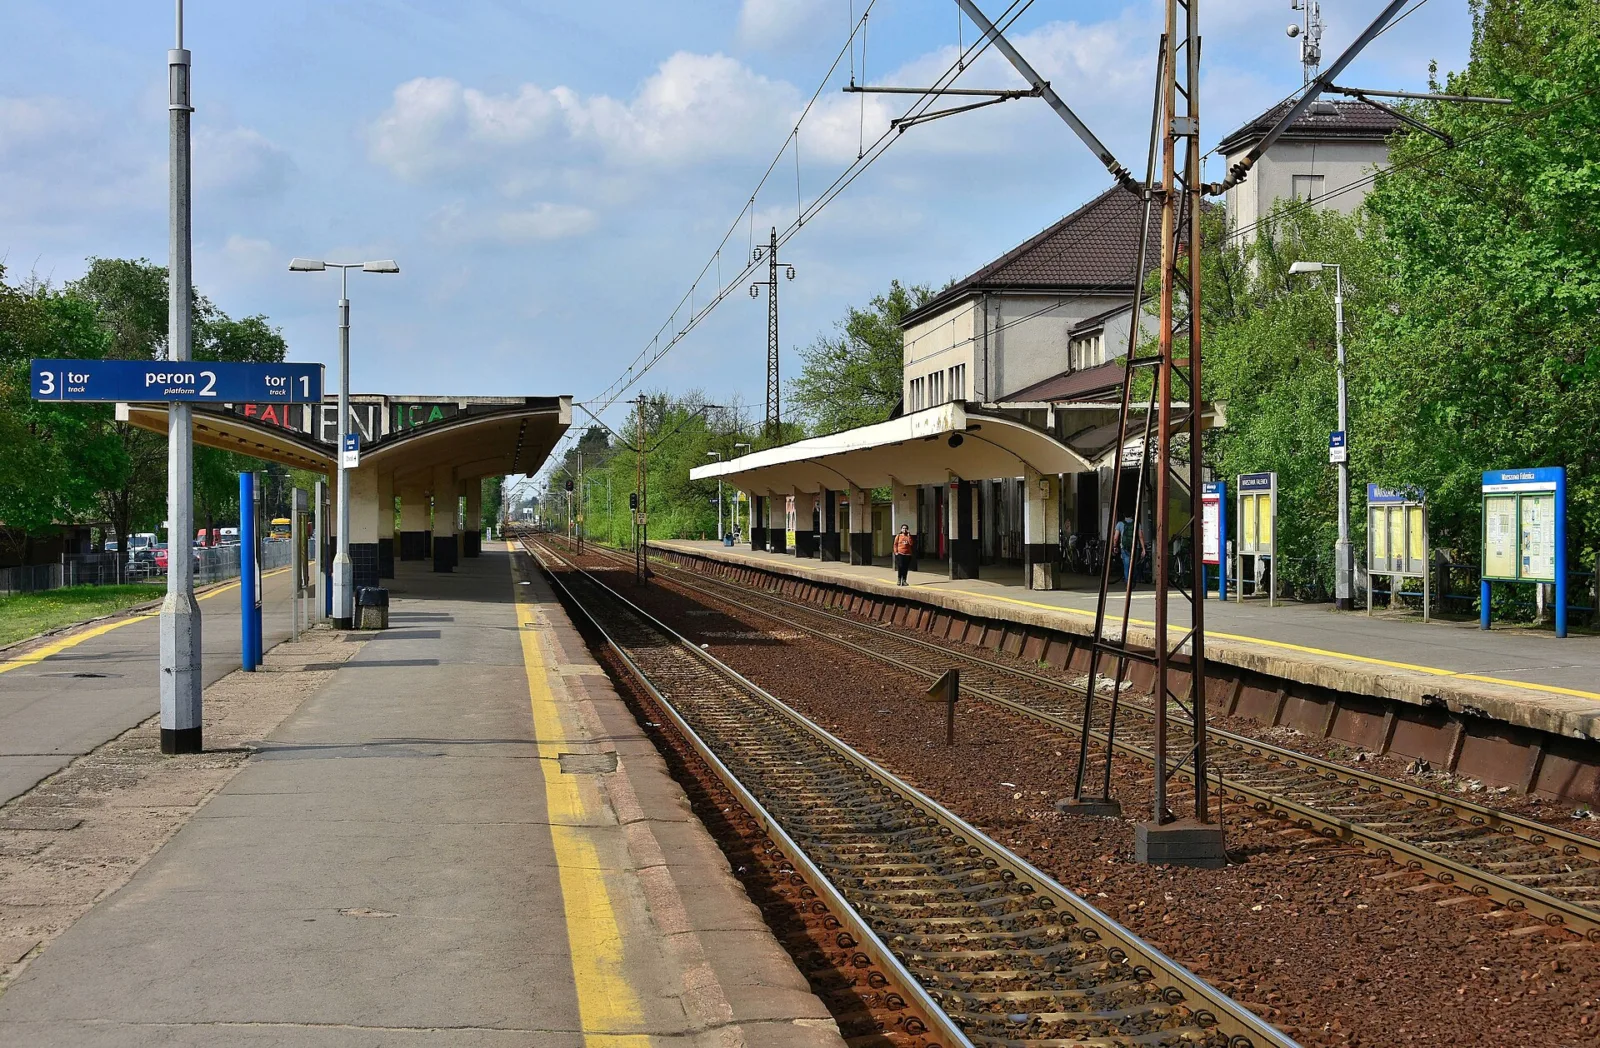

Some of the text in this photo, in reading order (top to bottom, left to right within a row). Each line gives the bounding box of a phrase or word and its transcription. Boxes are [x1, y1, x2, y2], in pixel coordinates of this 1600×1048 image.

[39, 371, 90, 395] 3 tor
[145, 371, 217, 396] peron 2
[164, 387, 195, 395] platform
[265, 375, 309, 398] tor 1
[269, 388, 287, 396] track
